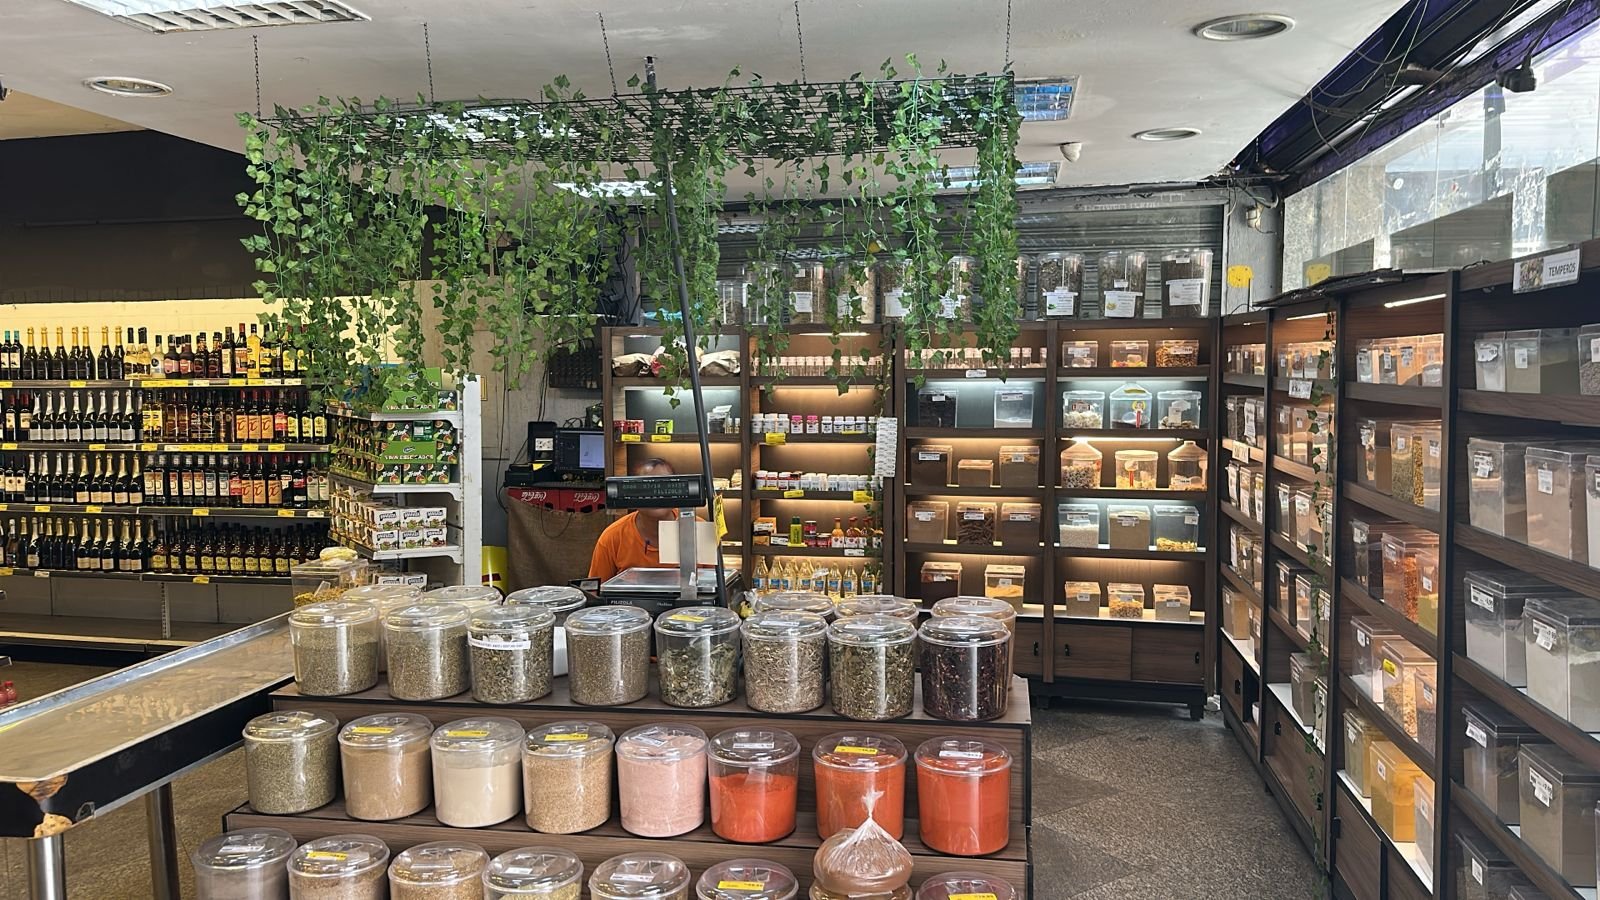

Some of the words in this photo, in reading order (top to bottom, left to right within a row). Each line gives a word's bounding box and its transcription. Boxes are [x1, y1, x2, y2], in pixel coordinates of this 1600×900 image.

[1548, 262, 1576, 277] TEMPEROS
[521, 491, 547, 502] Coca-Cola
[573, 492, 600, 503] Coca-Cola
